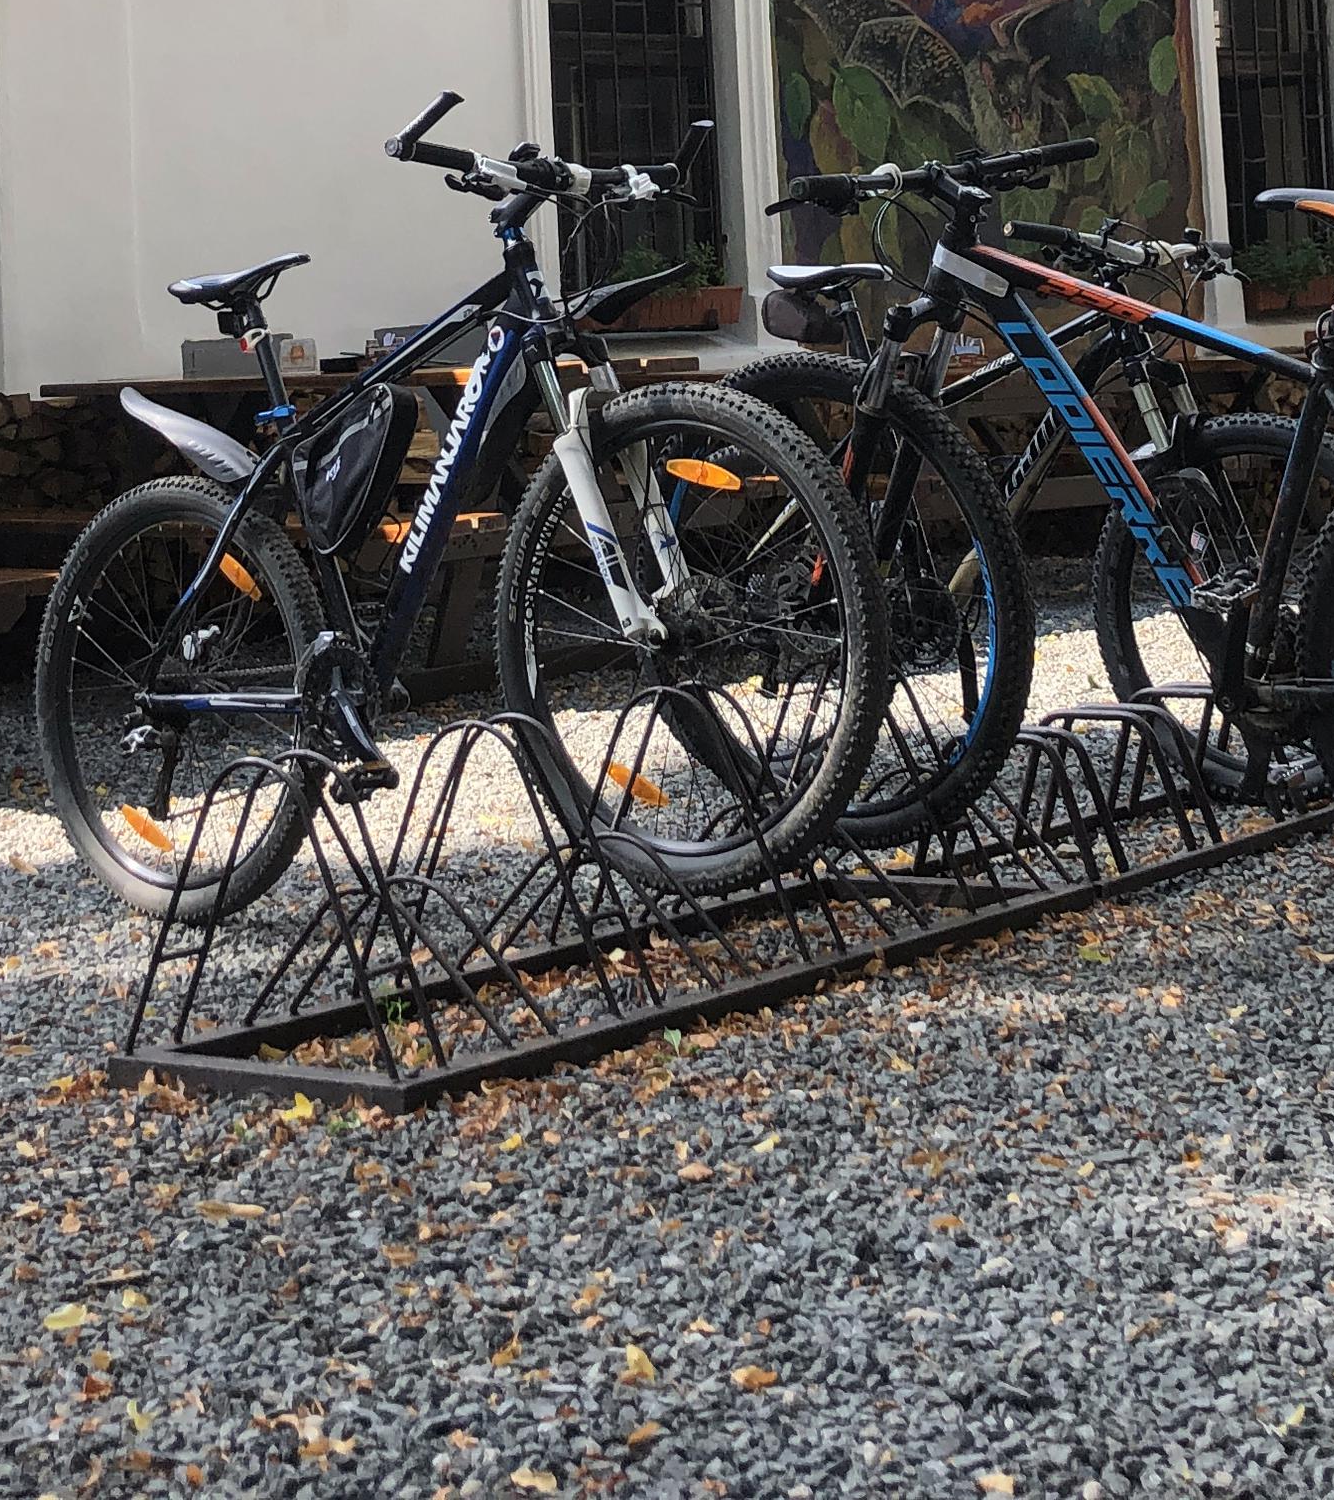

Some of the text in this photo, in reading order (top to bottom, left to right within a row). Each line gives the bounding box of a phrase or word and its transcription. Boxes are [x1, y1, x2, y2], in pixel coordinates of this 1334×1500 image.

[399, 372, 485, 575] KILIMANJARO
[508, 485, 551, 624] SCHWALBE
[998, 321, 1193, 607] LAPIERRE
